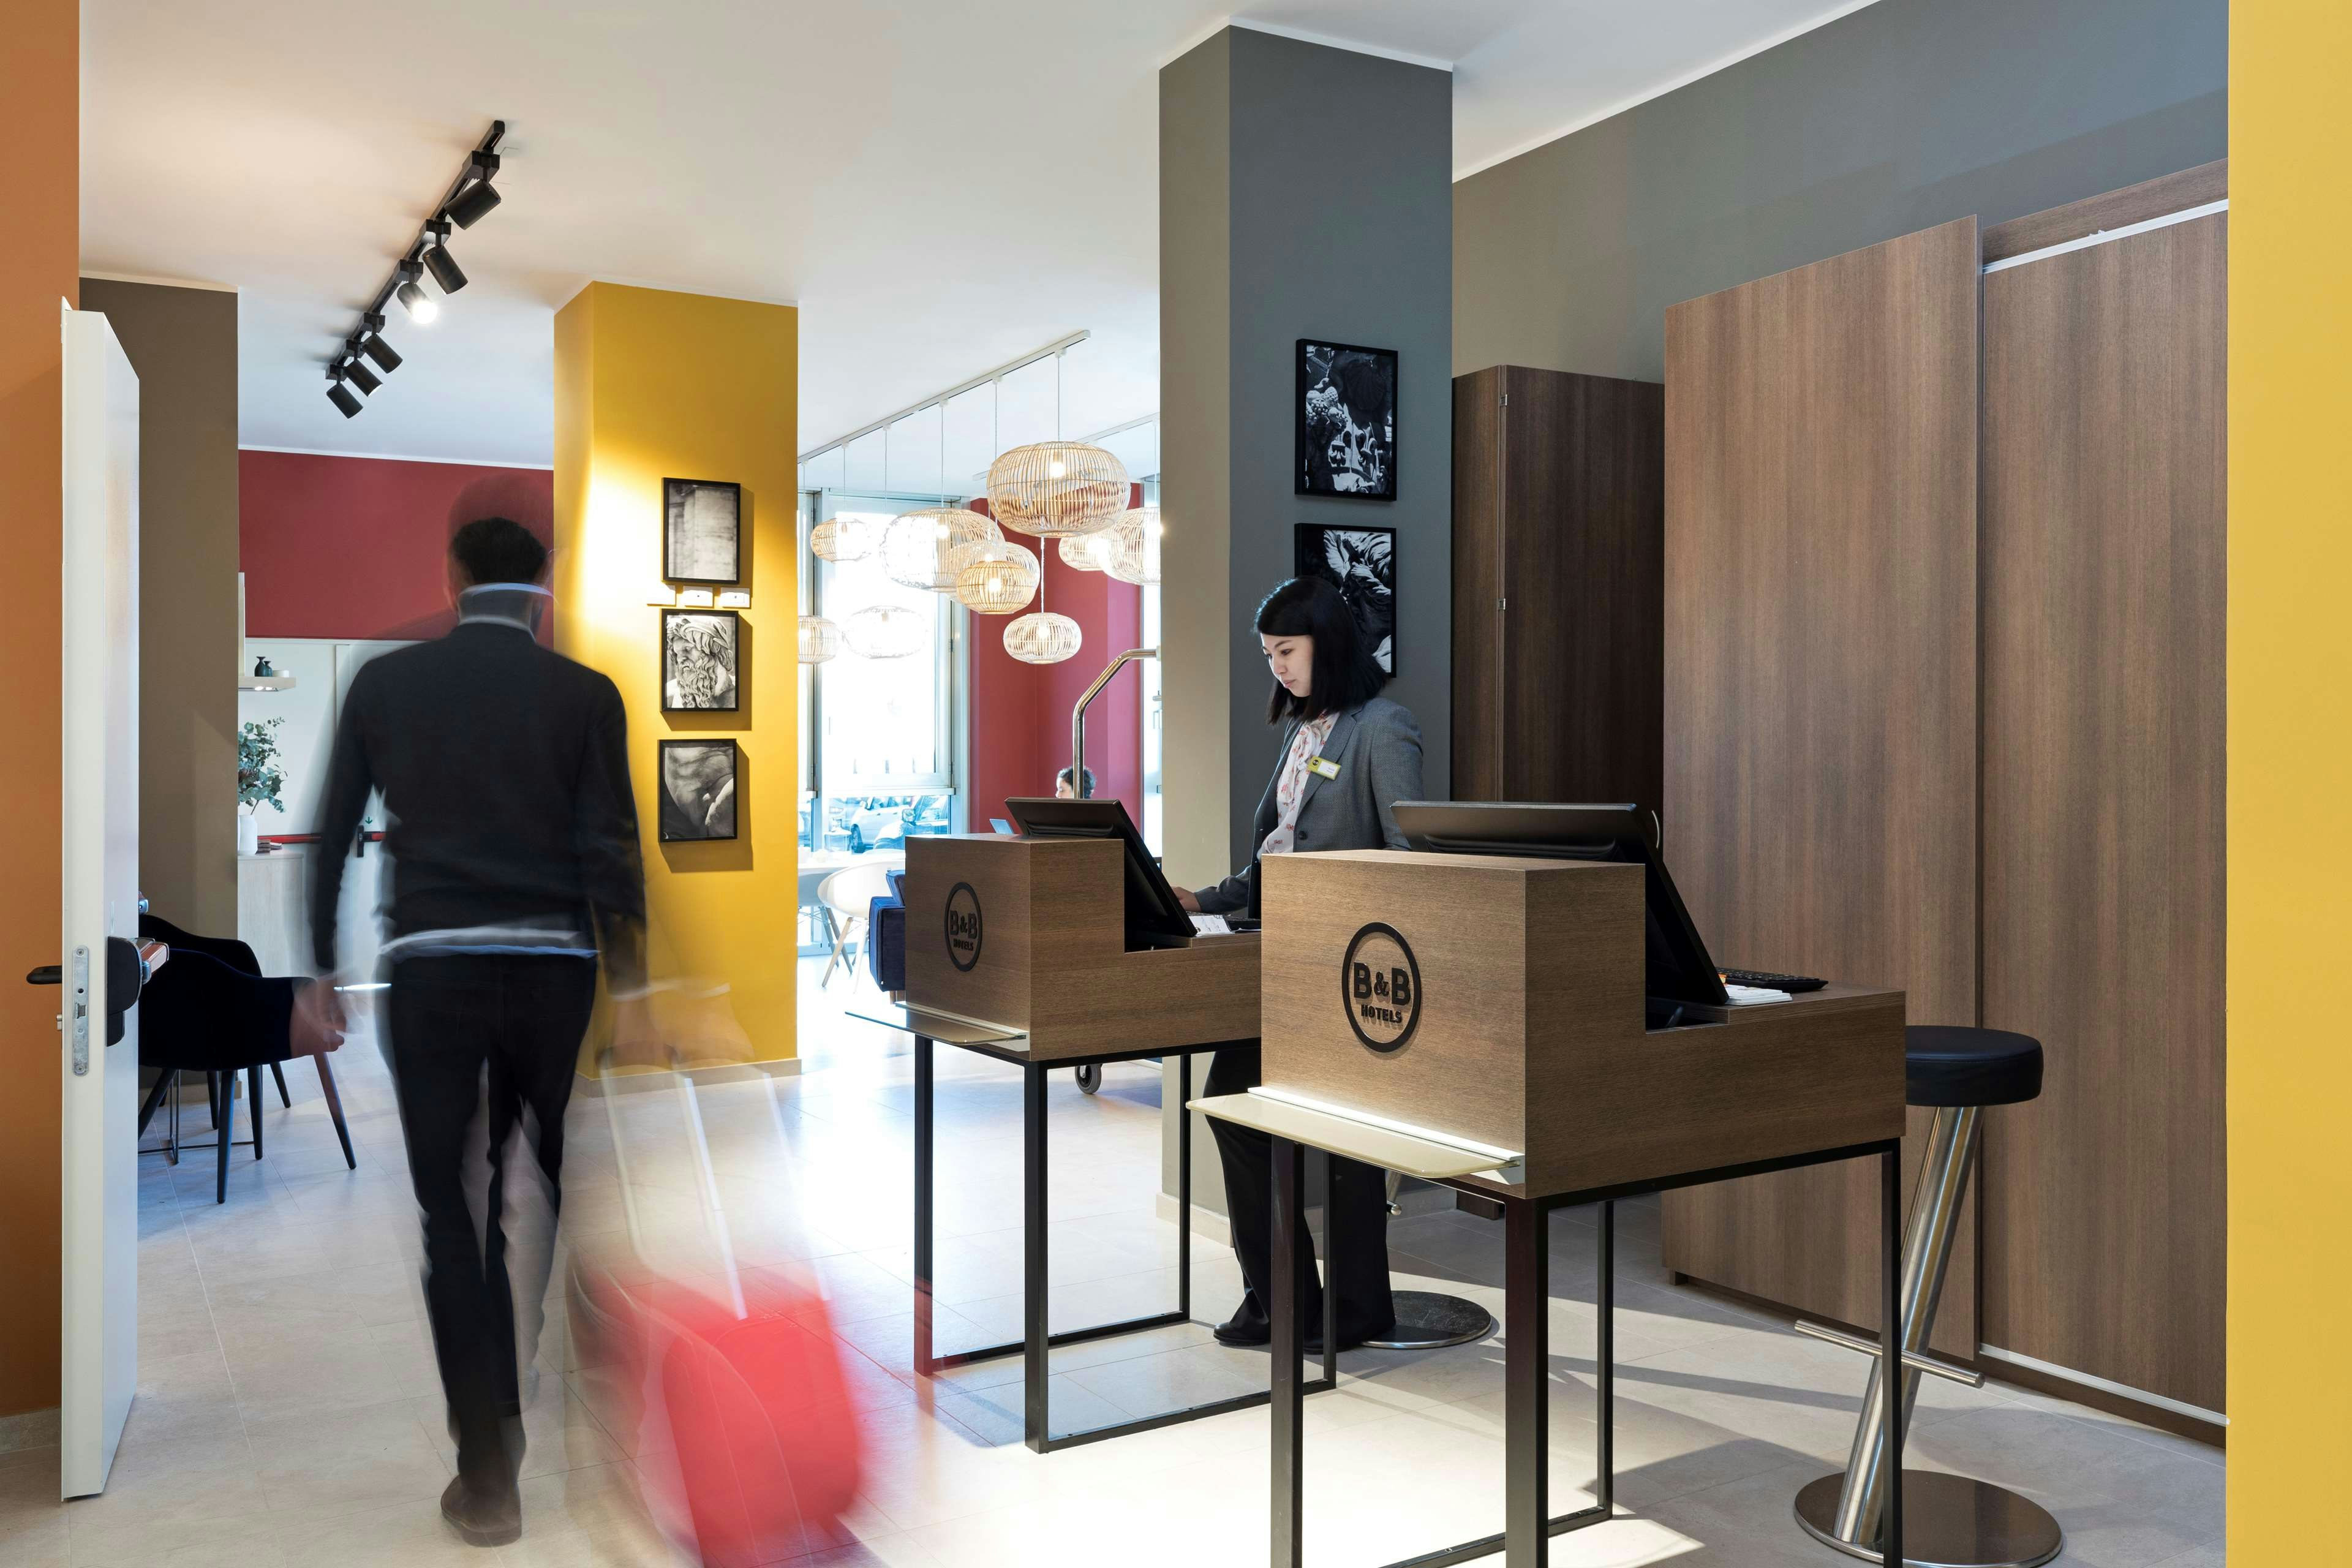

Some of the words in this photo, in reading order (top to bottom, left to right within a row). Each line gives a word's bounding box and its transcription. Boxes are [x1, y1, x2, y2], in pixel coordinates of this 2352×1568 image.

[950, 910, 978, 939] B&B
[1354, 962, 1411, 1005] B&B
[1361, 1004, 1402, 1023] HOTELS
